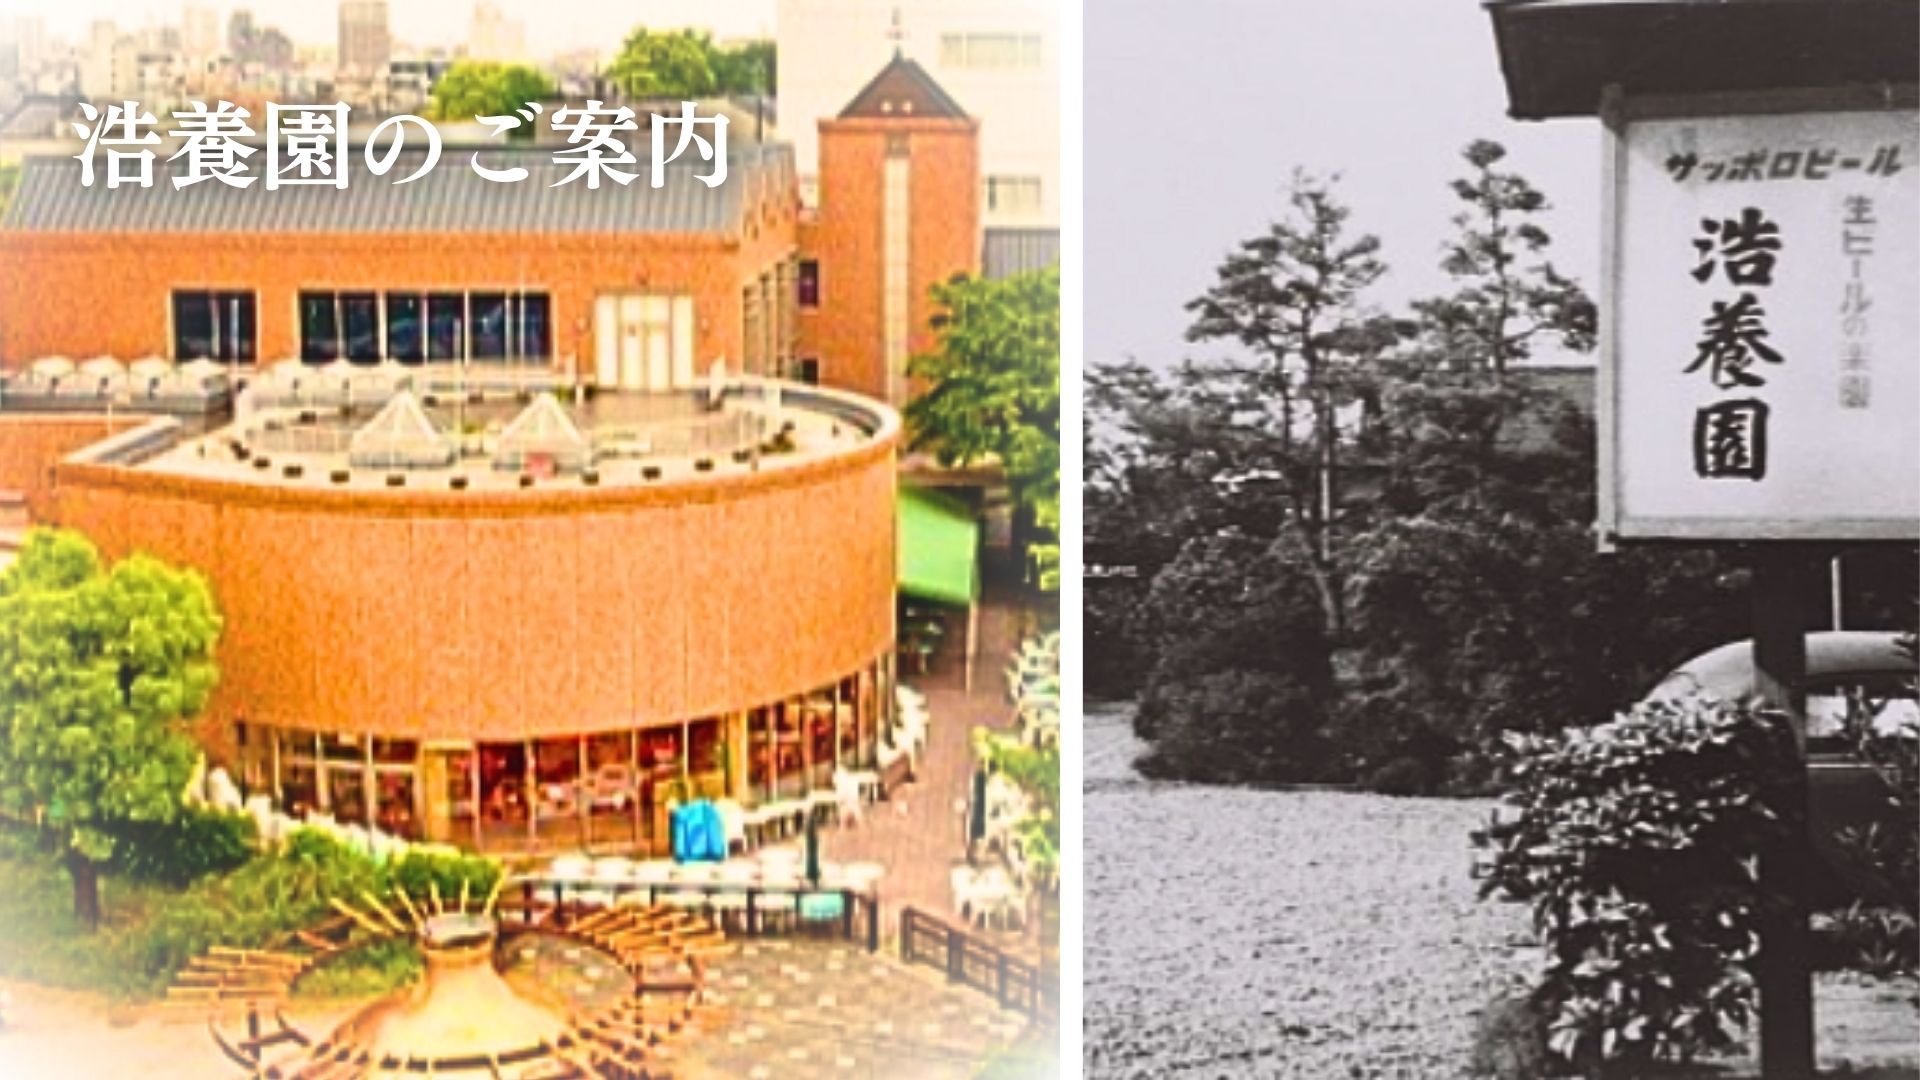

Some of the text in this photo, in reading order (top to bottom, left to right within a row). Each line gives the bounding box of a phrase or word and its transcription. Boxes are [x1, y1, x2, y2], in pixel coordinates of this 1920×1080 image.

[1665, 145, 1902, 182] サッポロビール
[1683, 207, 1785, 482] 浩養園
